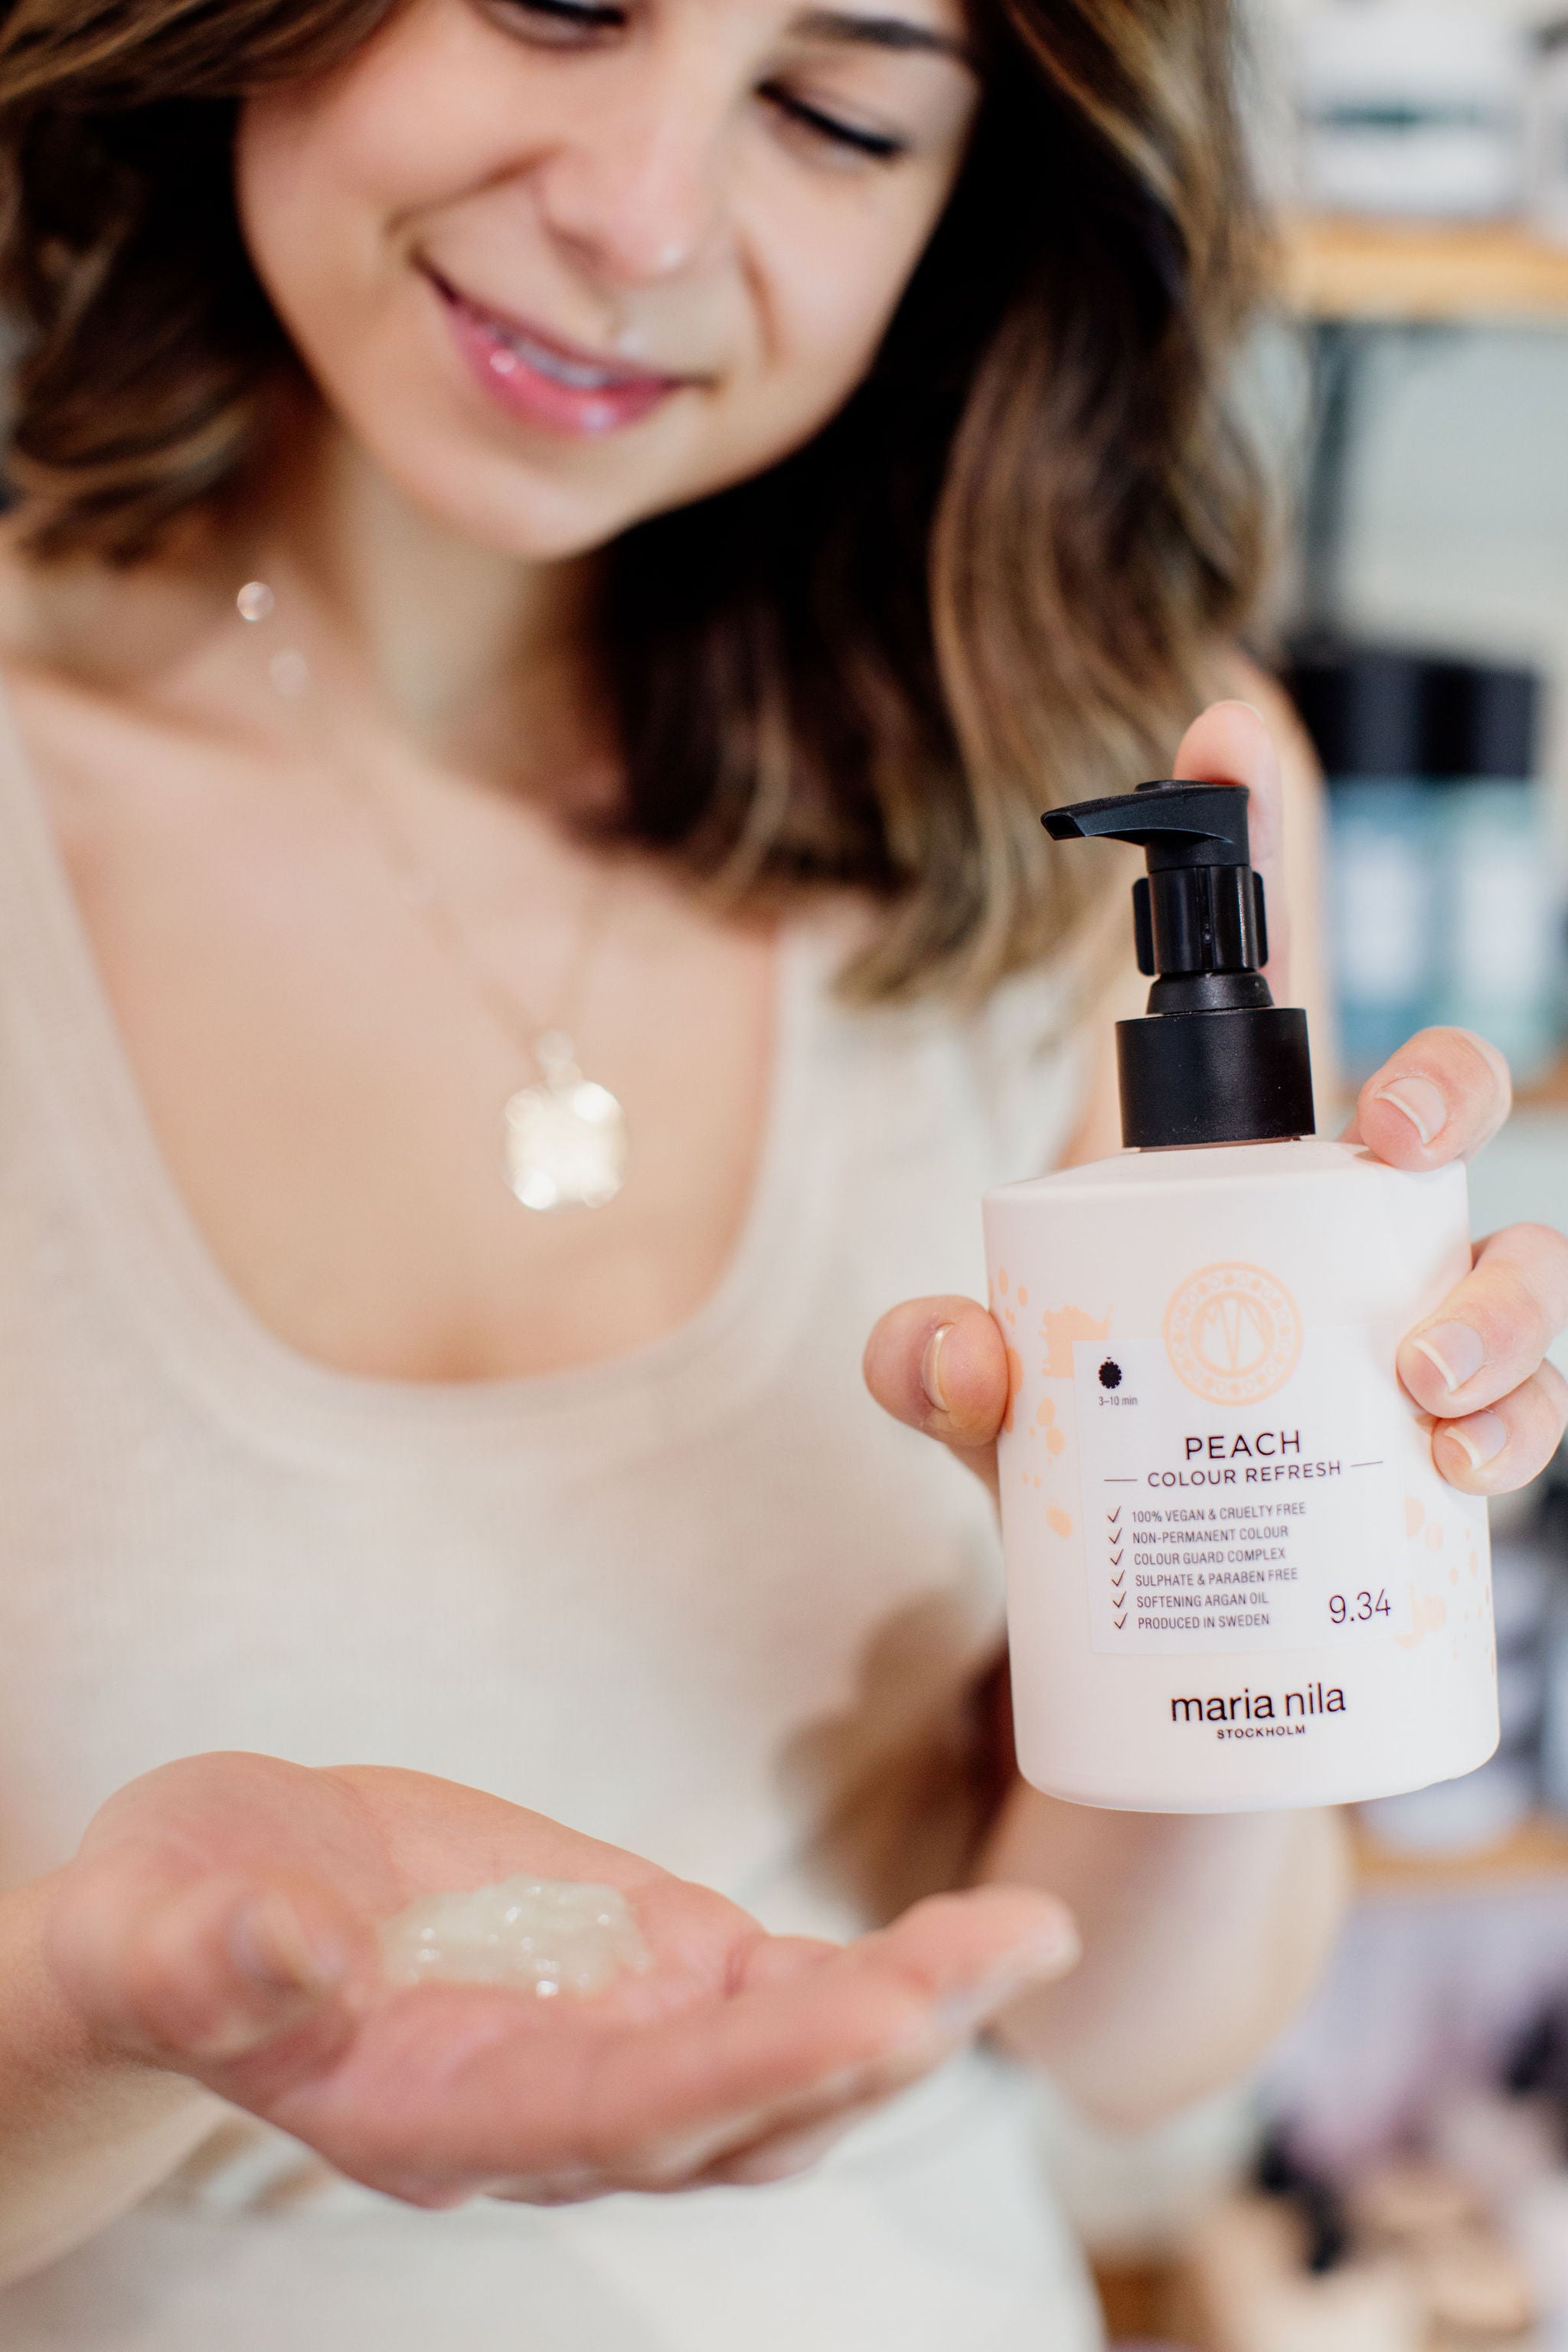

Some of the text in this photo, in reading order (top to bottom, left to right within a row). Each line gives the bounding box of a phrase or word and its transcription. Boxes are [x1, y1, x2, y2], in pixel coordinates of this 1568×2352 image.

[1121, 1396, 1138, 1405] min
[1185, 1430, 1300, 1460] PEACH
[1148, 1461, 1341, 1488] COLOUR REFRESH
[1132, 1502, 1305, 1523] 100% VEGAN & CRUELTY FREE
[1132, 1525, 1289, 1544] NON-PERMANENT COLOUR
[1134, 1547, 1285, 1566] COLOUR GUARD COMPLEX
[1135, 1567, 1298, 1586] SULPHATE & PARABEN FREE
[1136, 1592, 1269, 1609] SOFTENING ARGAN OIL
[1329, 1589, 1391, 1624] 9.34
[1138, 1613, 1270, 1629] PRODUCED IN SWEDEN
[1171, 1682, 1346, 1722] maria nila
[1217, 1725, 1305, 1740] STOCKHOLM
